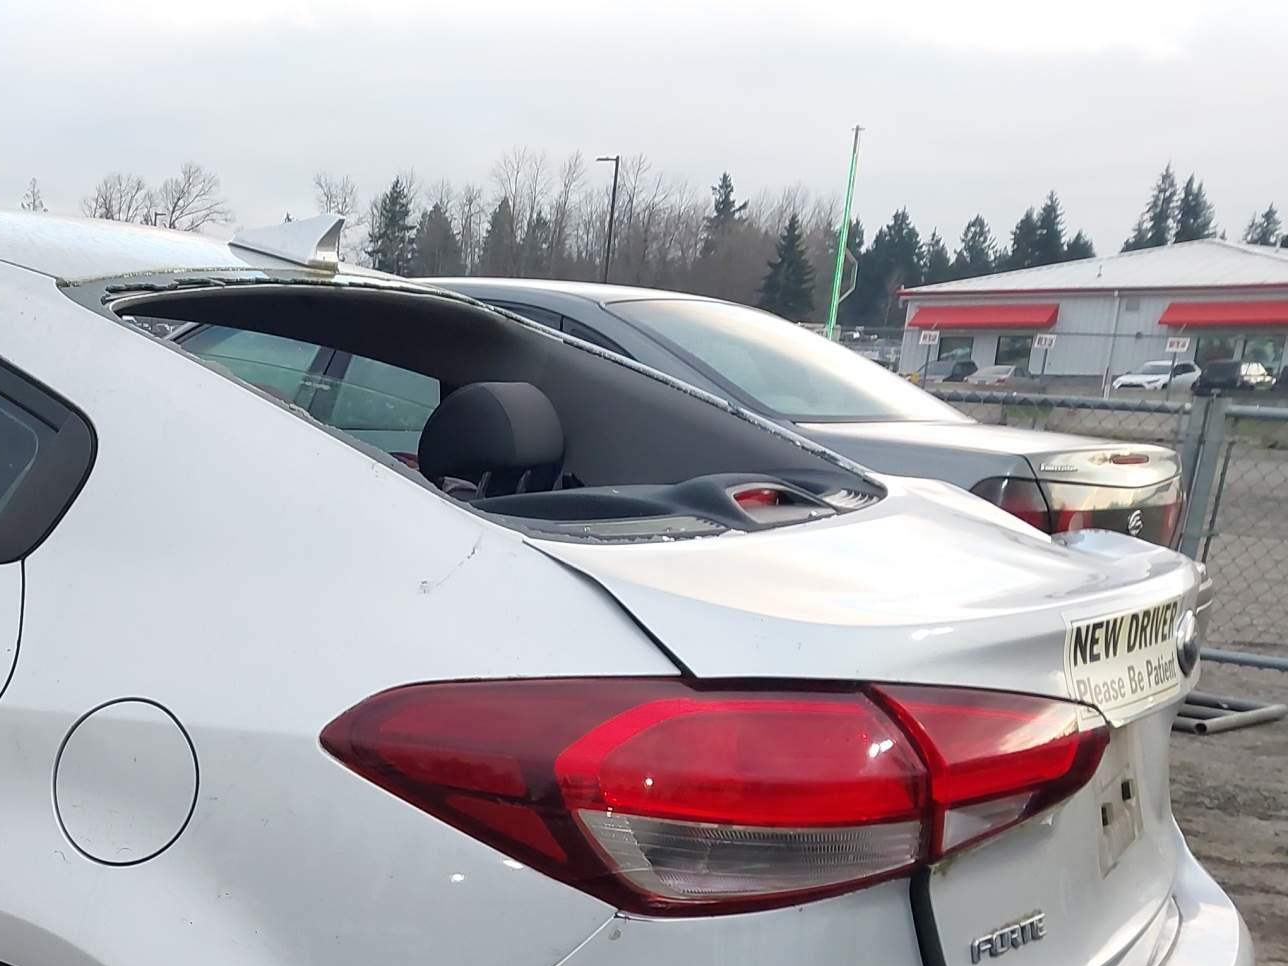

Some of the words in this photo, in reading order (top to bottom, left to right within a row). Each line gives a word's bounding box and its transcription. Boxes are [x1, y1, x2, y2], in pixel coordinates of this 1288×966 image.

[1073, 615, 1125, 667] NEW
[1126, 601, 1178, 654] DRIVER
[1076, 676, 1126, 705] Please
[1127, 665, 1145, 695] Be
[1145, 652, 1177, 689] Patient
[971, 912, 1047, 965] FORTE
